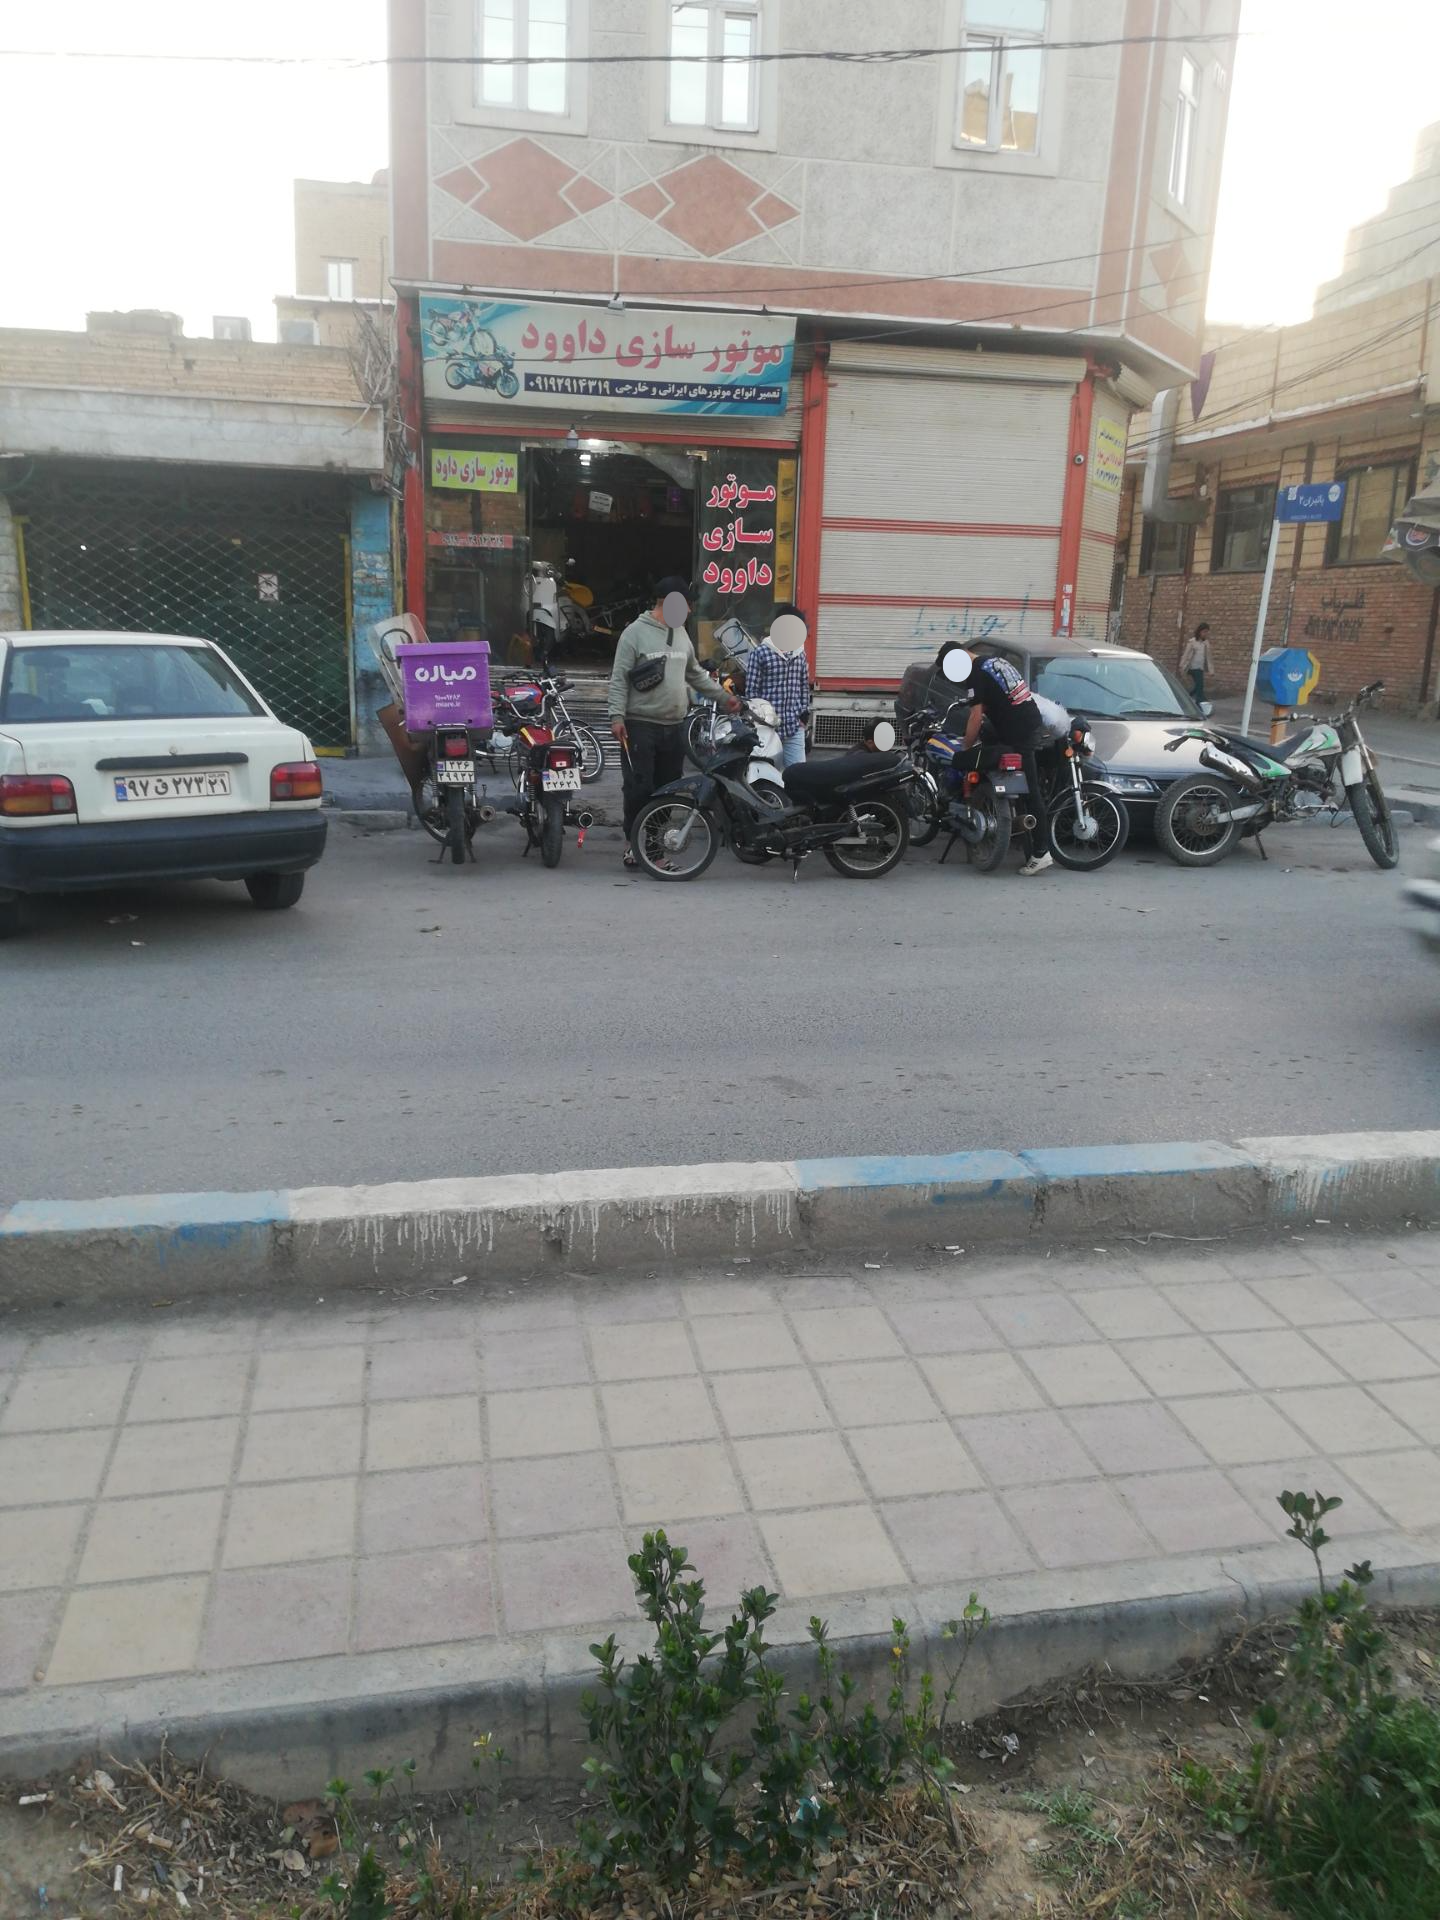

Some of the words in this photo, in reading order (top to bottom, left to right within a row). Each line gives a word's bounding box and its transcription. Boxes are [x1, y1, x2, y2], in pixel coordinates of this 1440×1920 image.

[521, 319, 606, 364] داوود
[615, 324, 696, 369] سازی
[702, 329, 783, 374] موتور
[615, 381, 649, 395] خارجی
[651, 386, 657, 396] و
[659, 383, 688, 397] ایرانی
[732, 387, 756, 400] انواع
[757, 388, 781, 400] تعمیر
[435, 455, 458, 482] داود
[460, 456, 487, 484] سازی
[705, 473, 776, 509] موتور
[703, 516, 774, 552] سازی
[703, 557, 773, 594] داوود
[415, 665, 477, 686] میاره
[128, 779, 149, 797] ۹۷
[172, 776, 204, 795] ۲۷۳
[208, 778, 228, 794] ۲۱
